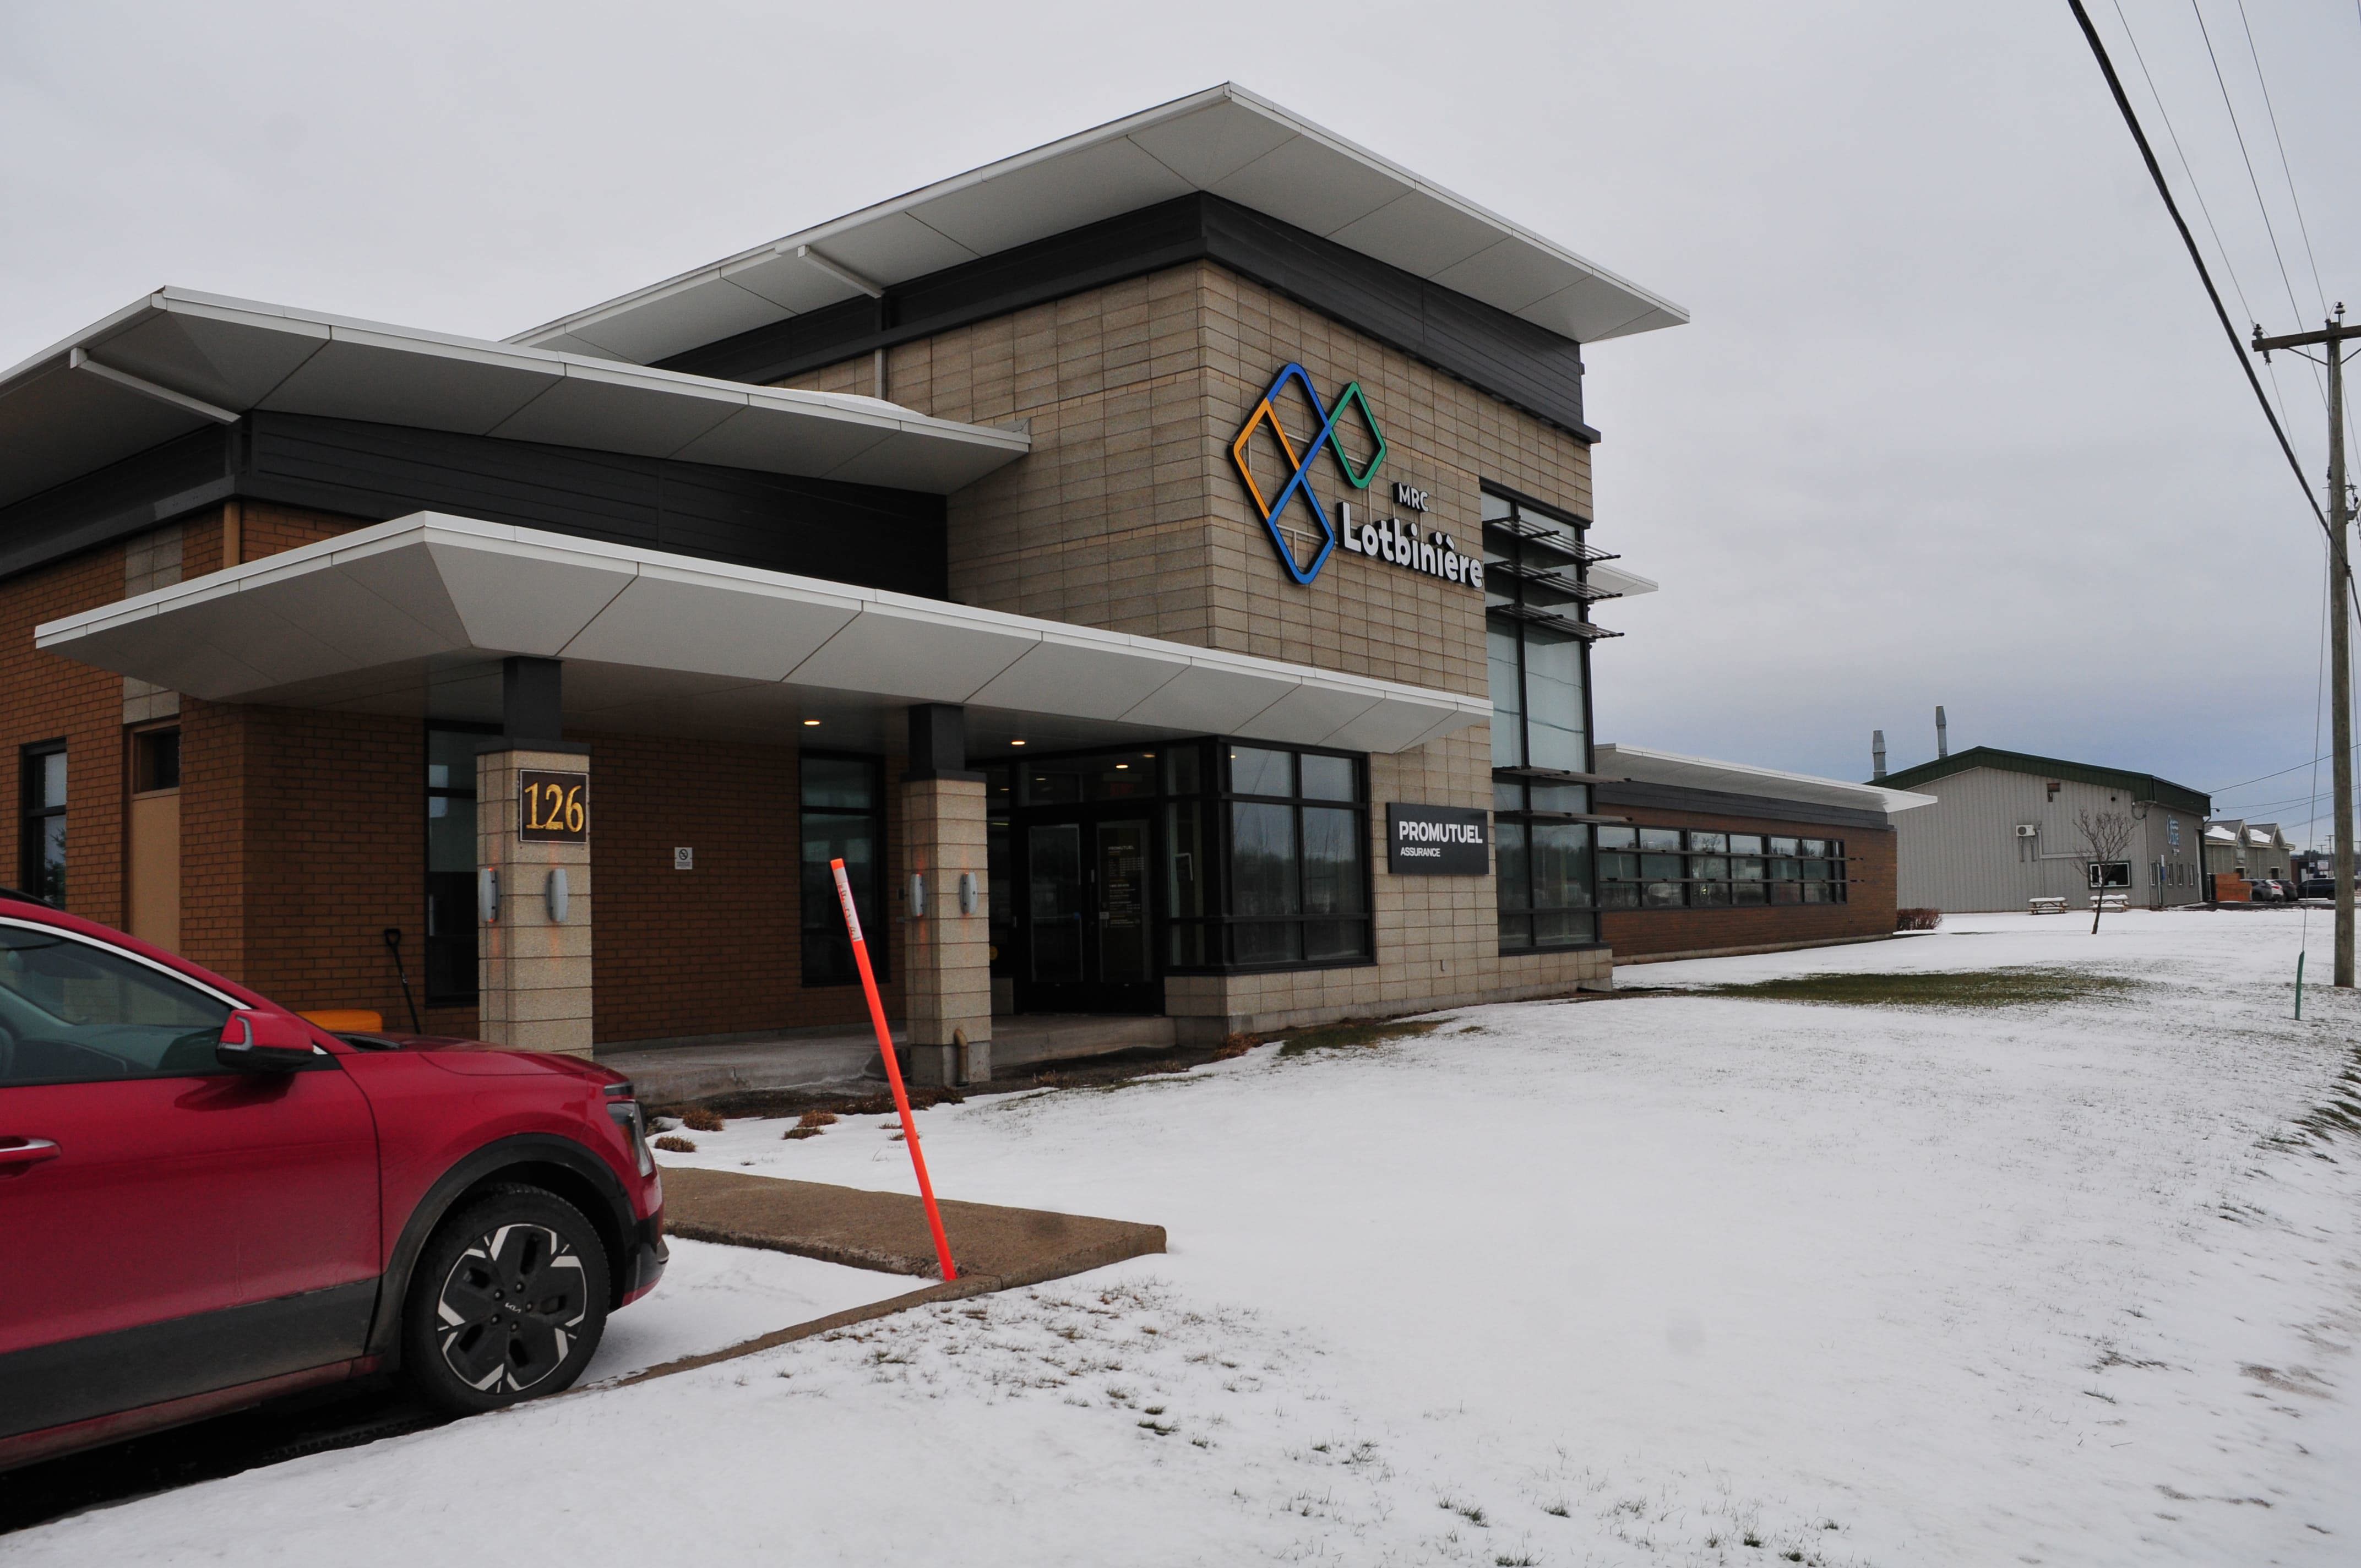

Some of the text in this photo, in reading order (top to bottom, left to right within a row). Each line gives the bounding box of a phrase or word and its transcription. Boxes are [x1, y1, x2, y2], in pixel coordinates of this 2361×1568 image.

[1396, 482, 1429, 512] MRC
[1341, 501, 1484, 587] Lotbinière
[524, 782, 584, 832] 126
[1399, 820, 1483, 844] PROMUTUEL
[1400, 847, 1441, 857] ASSURANCE
